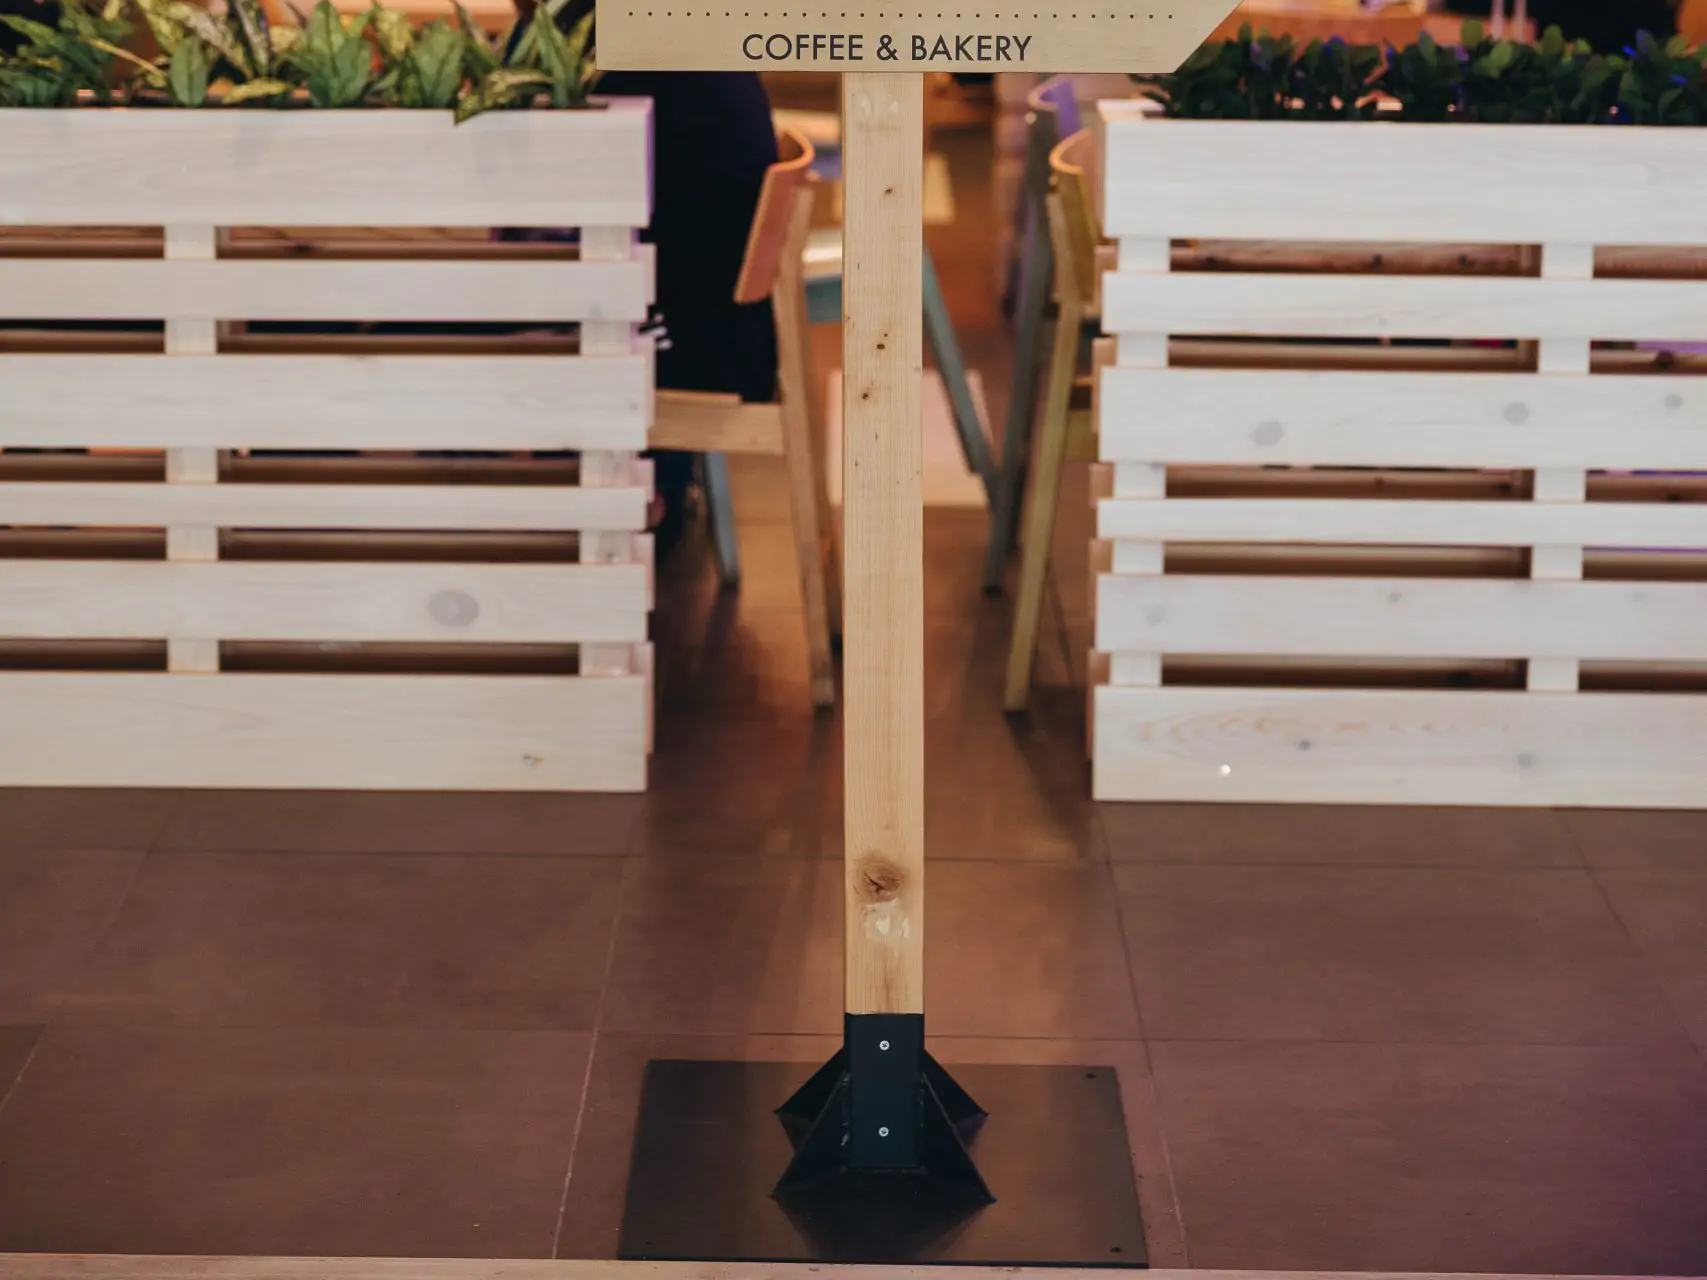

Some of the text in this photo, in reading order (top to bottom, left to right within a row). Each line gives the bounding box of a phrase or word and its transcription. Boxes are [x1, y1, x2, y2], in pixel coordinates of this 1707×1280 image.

[742, 33, 1034, 62] COFFEE & BAKERY
